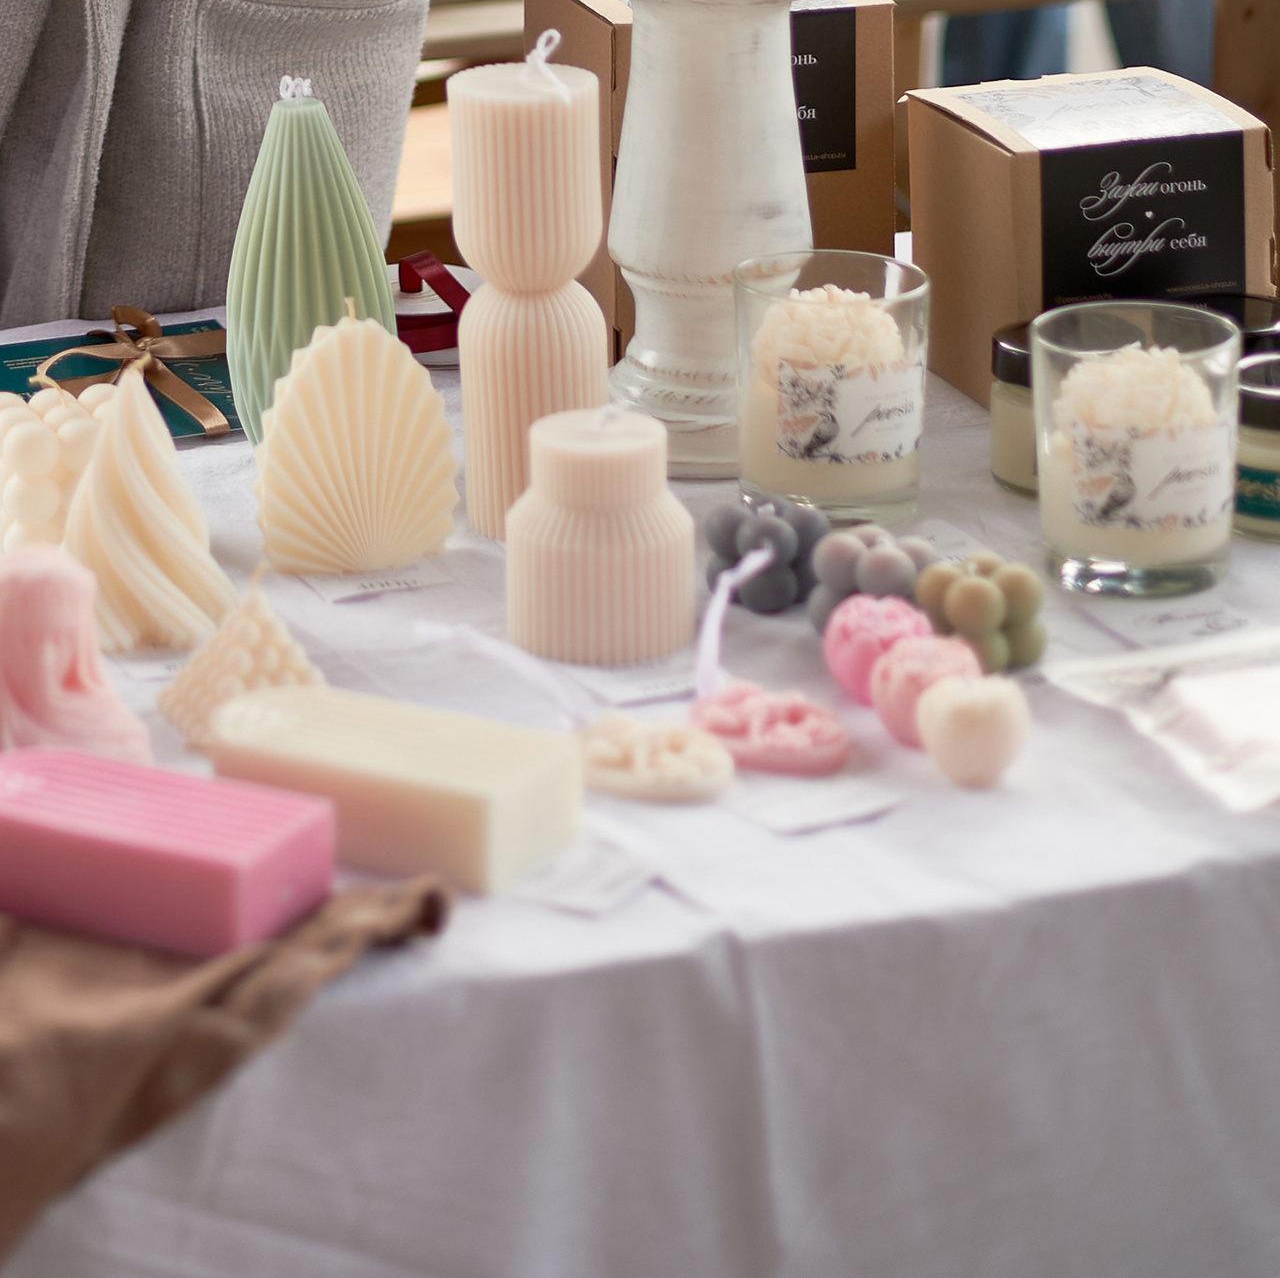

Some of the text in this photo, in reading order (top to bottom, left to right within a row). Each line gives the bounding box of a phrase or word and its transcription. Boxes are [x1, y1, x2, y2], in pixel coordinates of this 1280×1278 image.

[1079, 161, 1207, 221] Зажги огонь
[1170, 233, 1207, 249] себя
